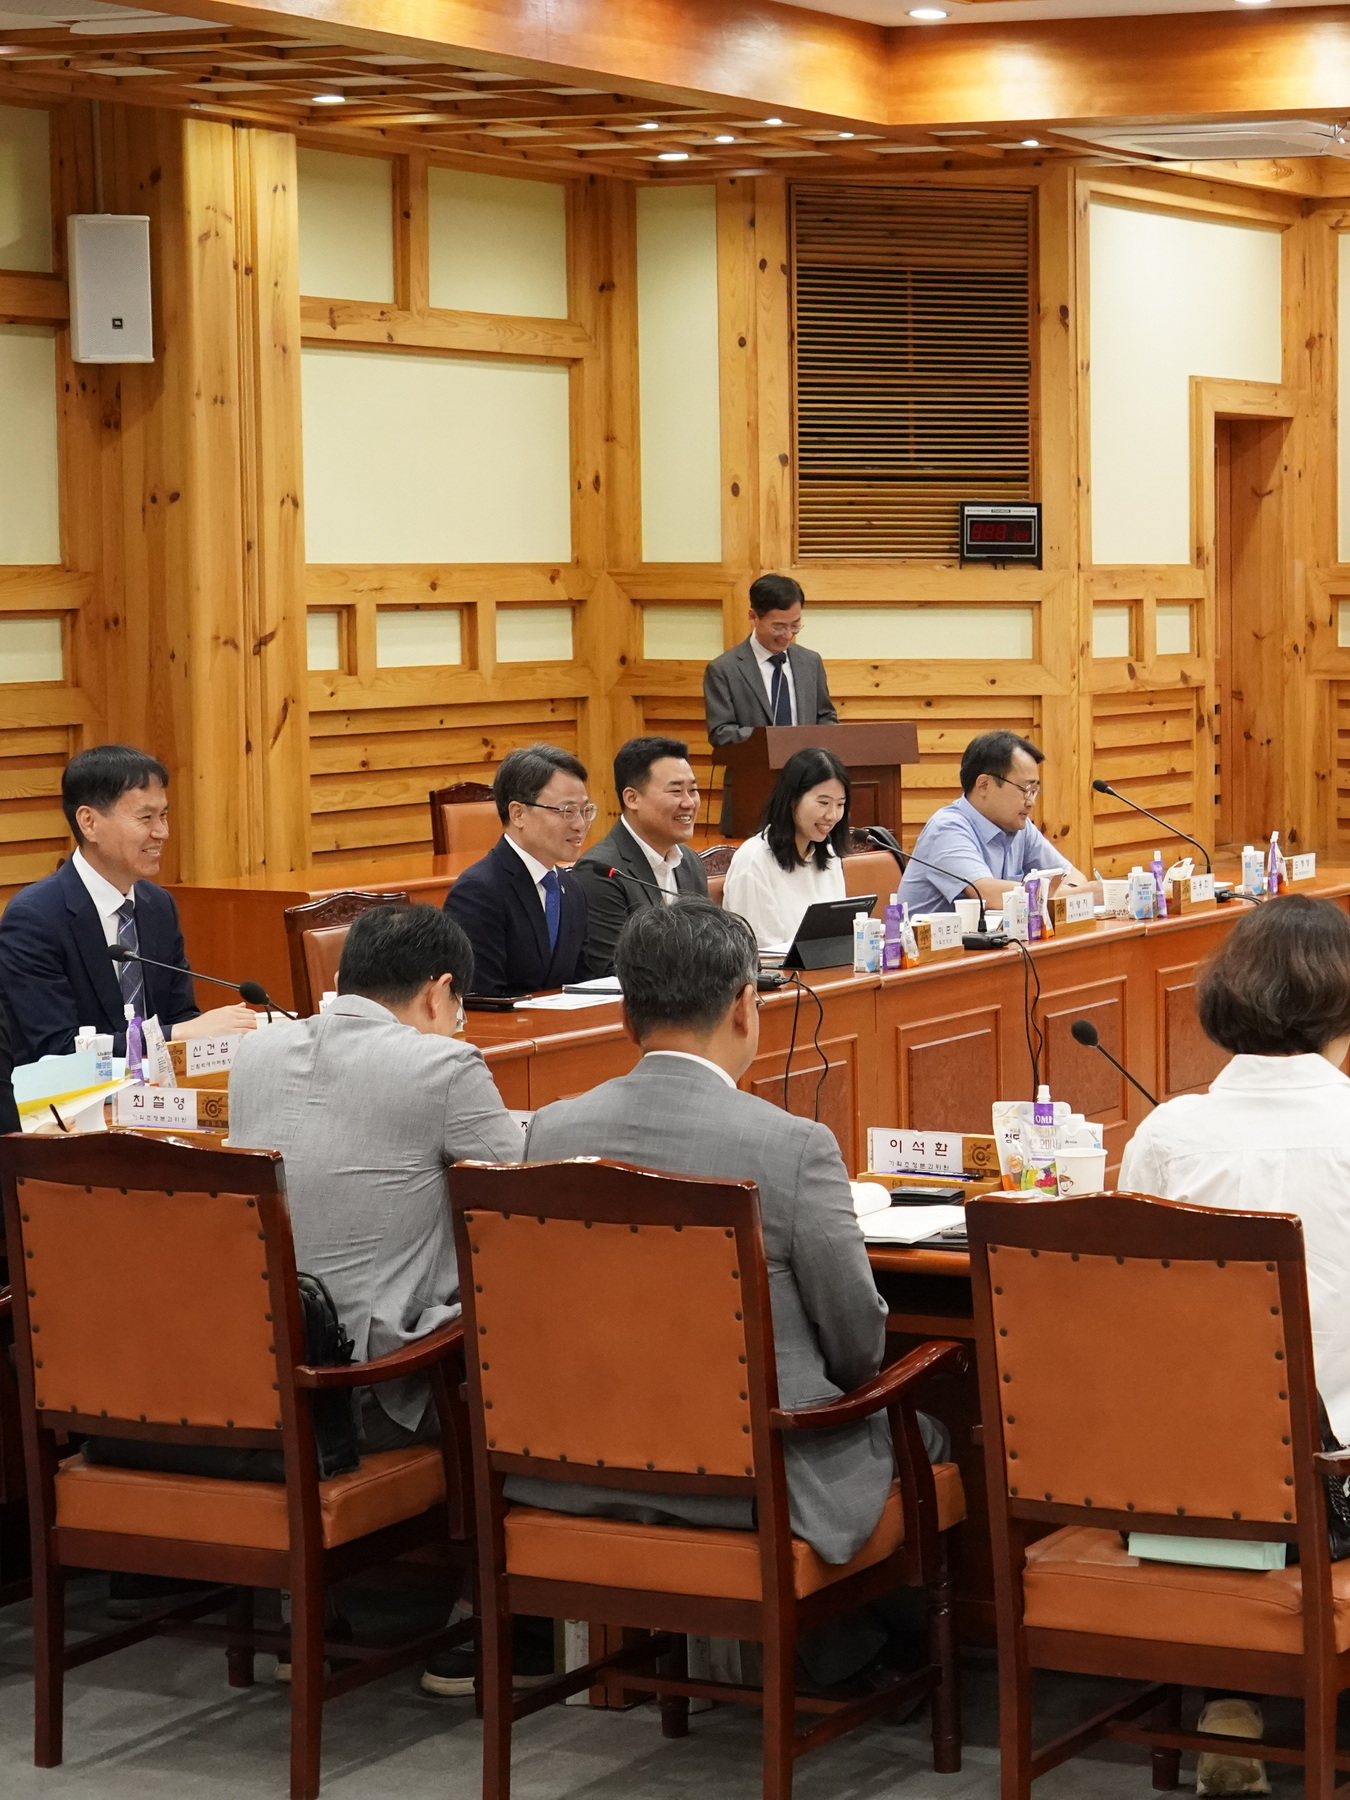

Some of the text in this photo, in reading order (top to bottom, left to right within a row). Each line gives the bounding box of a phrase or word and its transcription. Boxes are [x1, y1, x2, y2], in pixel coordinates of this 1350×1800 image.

[193, 1041, 229, 1058] 신건섭
[133, 1094, 185, 1111] 최철영
[890, 1139, 948, 1157] 이석환
